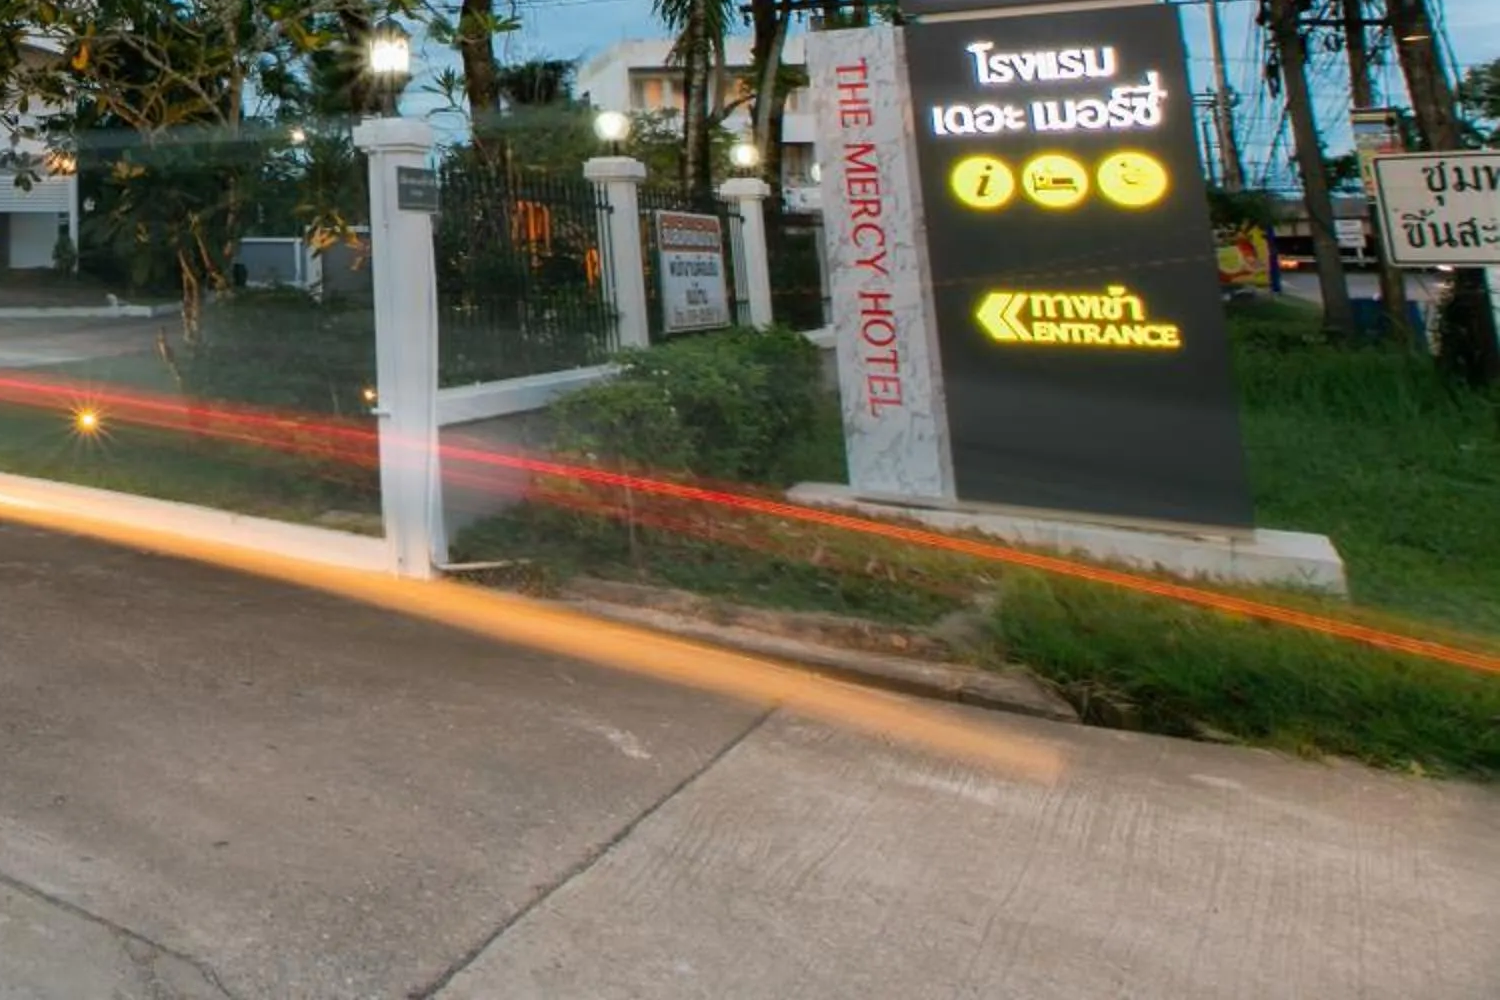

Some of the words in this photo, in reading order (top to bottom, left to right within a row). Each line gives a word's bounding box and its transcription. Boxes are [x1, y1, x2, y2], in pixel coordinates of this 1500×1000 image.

[966, 41, 1116, 85] โรงแรม
[836, 57, 873, 127] THE
[931, 103, 1027, 136] เดอะ
[844, 141, 889, 276] MERCY
[857, 290, 902, 418] HOTEL
[1032, 321, 1181, 348] ENTRANCE
